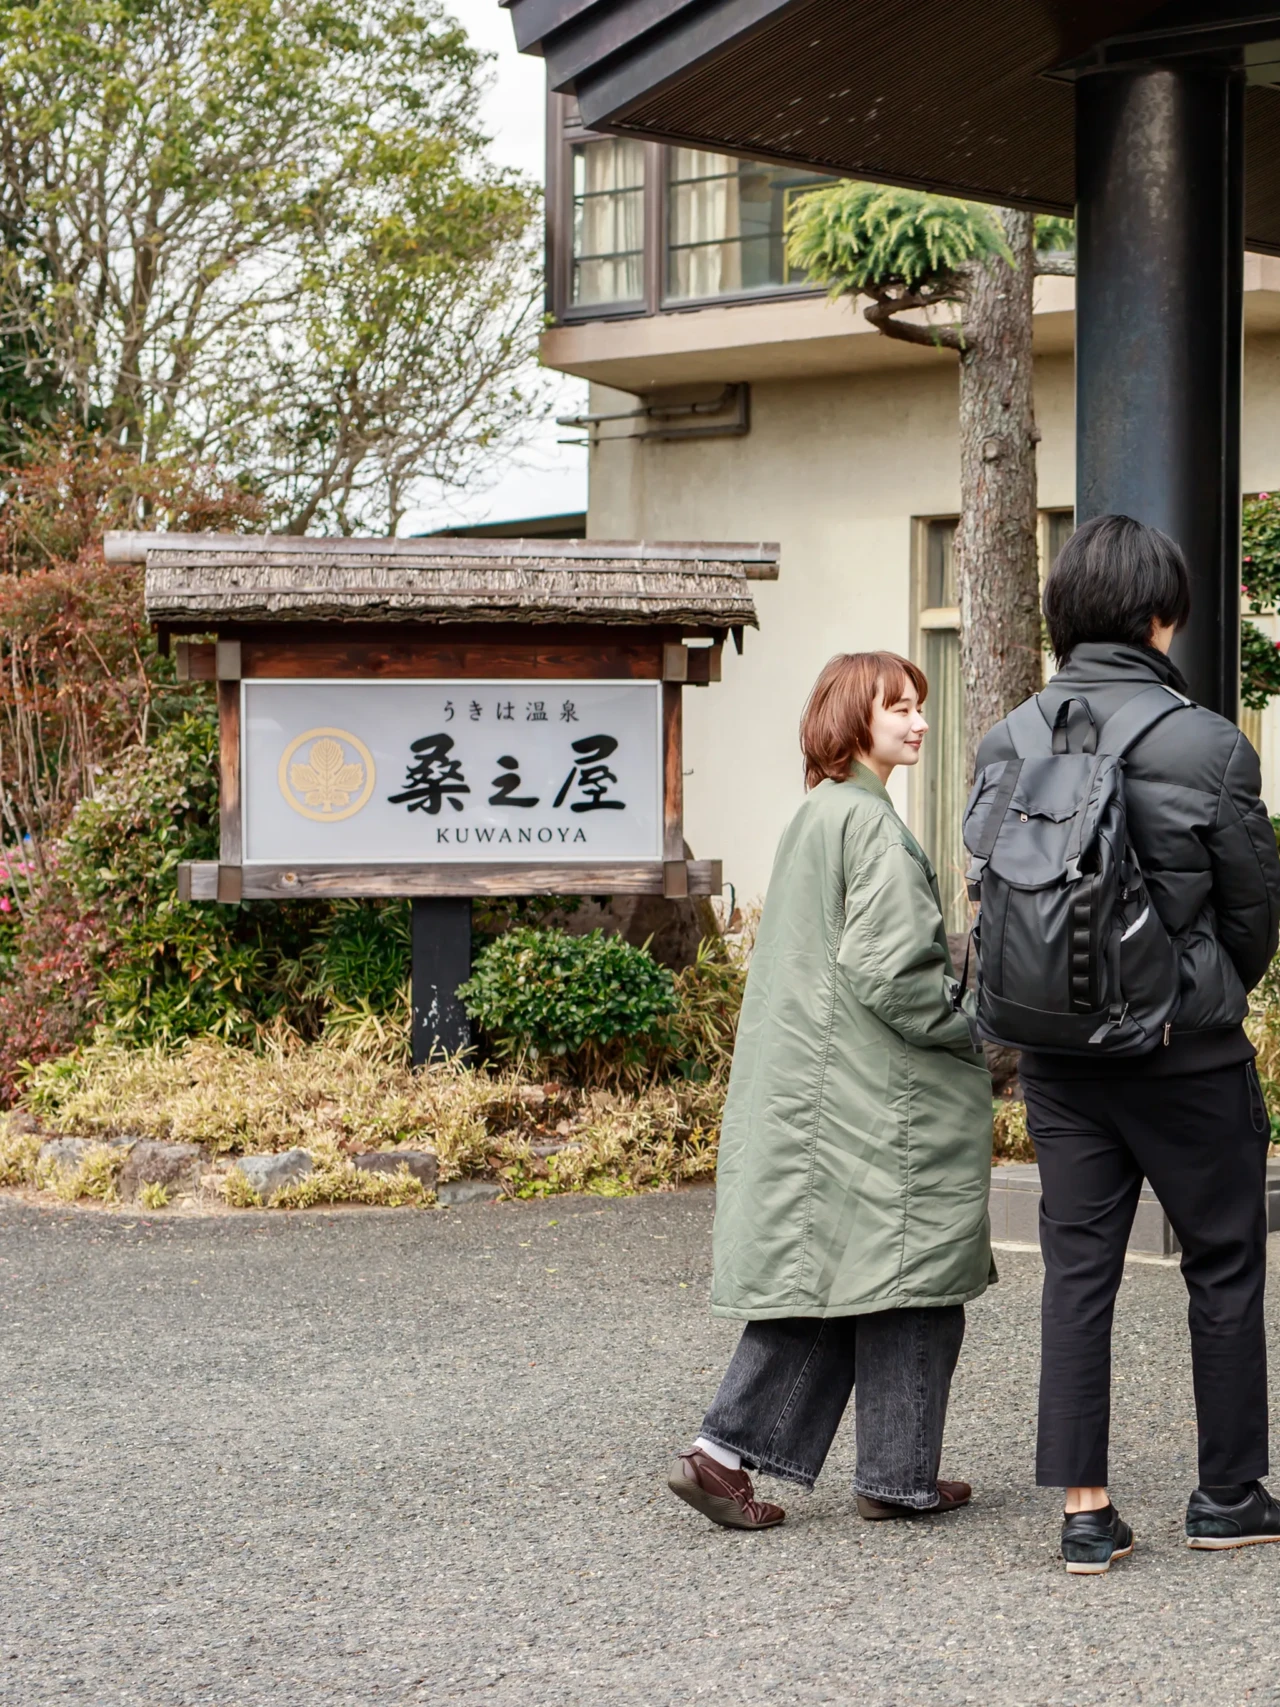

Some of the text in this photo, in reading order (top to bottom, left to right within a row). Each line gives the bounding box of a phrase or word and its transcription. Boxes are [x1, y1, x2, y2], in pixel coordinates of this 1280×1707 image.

[443, 699, 581, 723] うきは温泉
[387, 732, 627, 815] 桑之屋
[436, 827, 588, 844] KUWANOYA
